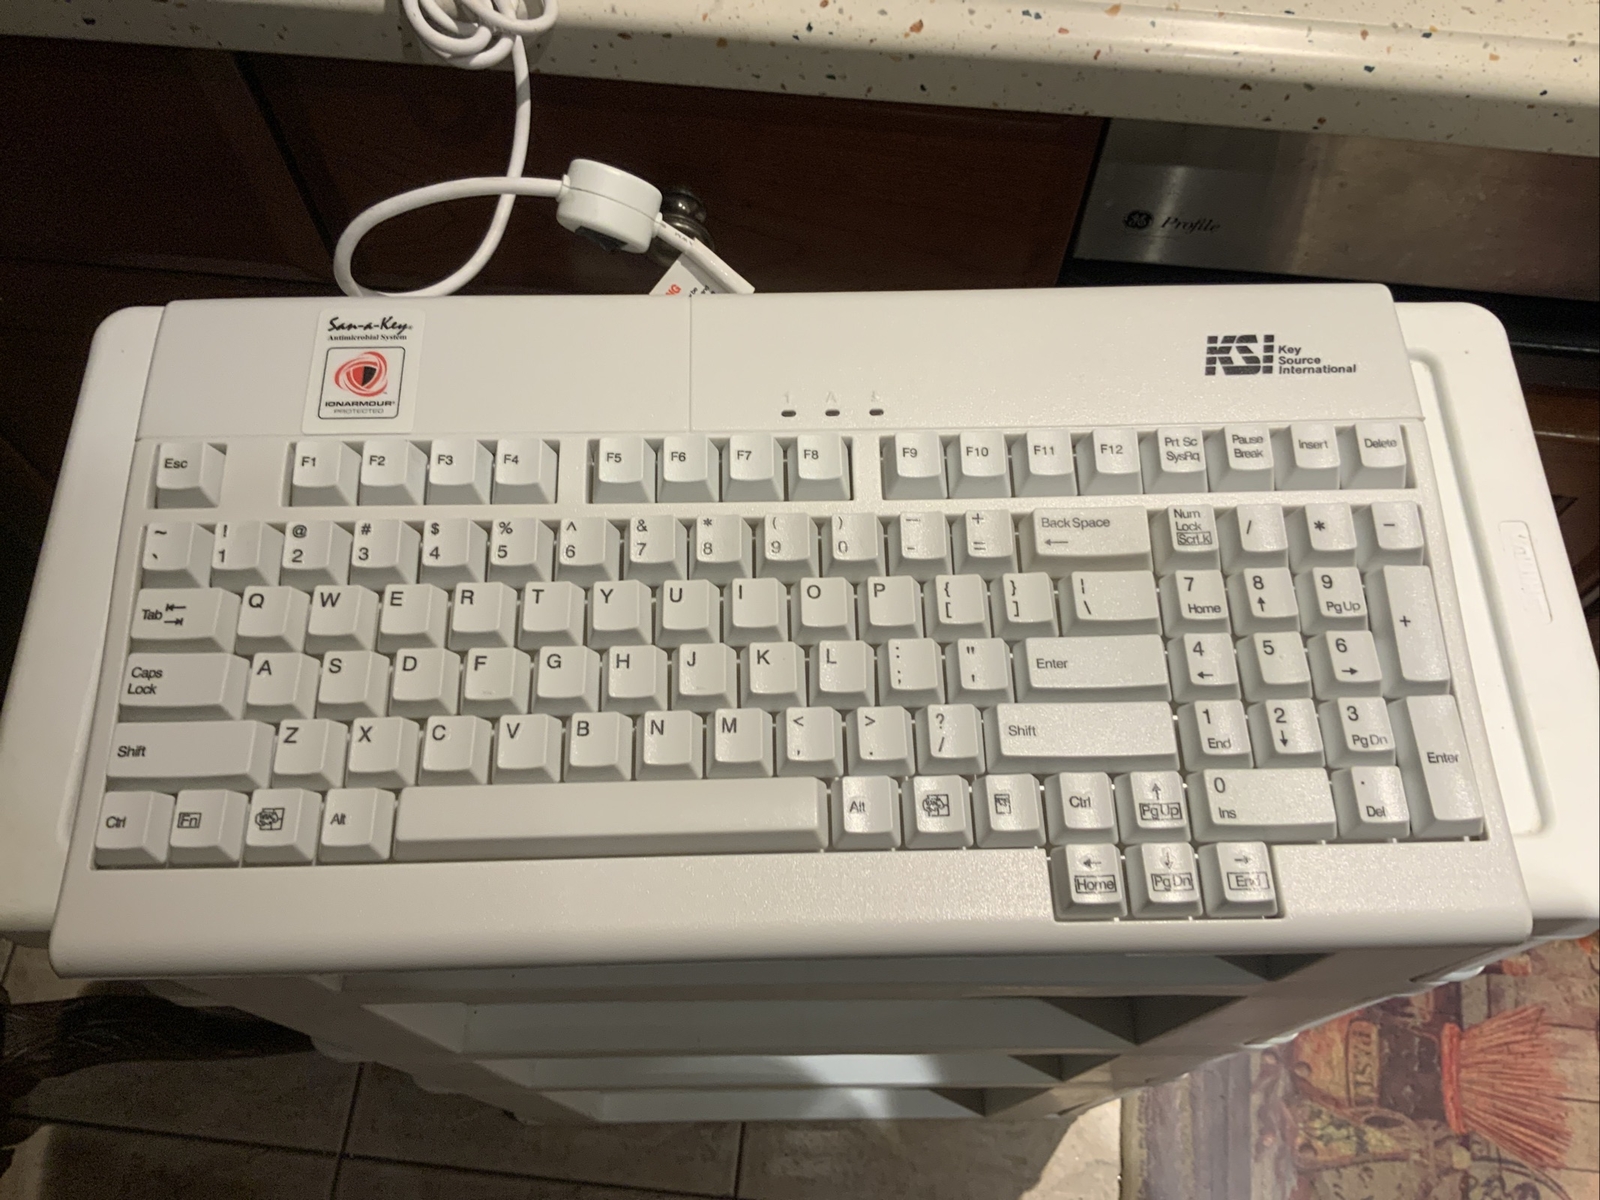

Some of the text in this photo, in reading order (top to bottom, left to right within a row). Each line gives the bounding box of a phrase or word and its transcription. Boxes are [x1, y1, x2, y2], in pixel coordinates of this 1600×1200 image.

[1161, 216, 1221, 234] Profile
[1205, 335, 1274, 375] KSI
[1278, 345, 1302, 356] Key
[1278, 355, 1321, 365] Source
[1278, 364, 1357, 375] International
[1164, 437, 1198, 447] Prt Sc
[1232, 434, 1264, 444] Pause
[1298, 440, 1328, 449] Insert
[1364, 438, 1397, 448] Delete
[737, 450, 752, 460] F7
[804, 449, 819, 460] F8
[902, 447, 918, 458] F9
[966, 446, 989, 457] F10
[1033, 445, 1054, 455] F11
[1100, 444, 1123, 454] F12
[1234, 448, 1263, 458] Break
[301, 456, 316, 467] F1
[369, 455, 385, 466] F2
[438, 454, 453, 465] F3
[504, 454, 519, 464] F4
[606, 452, 622, 463] F5
[671, 451, 686, 462] F6
[164, 458, 187, 469] Esc
[972, 513, 984, 524] +
[1173, 509, 1200, 519] Num
[361, 523, 371, 535] #
[431, 522, 439, 535] $
[499, 522, 513, 534] %
[636, 519, 647, 532] &
[1041, 517, 1110, 530] Back Space
[1175, 521, 1202, 535] Lock
[292, 525, 307, 538] @
[429, 546, 440, 559] 4
[498, 545, 507, 558] 5
[565, 545, 575, 558] 6
[637, 542, 647, 556] 7
[703, 542, 713, 555] 8
[771, 540, 781, 553] 9
[838, 540, 848, 554] 0
[219, 549, 225, 563] 1
[291, 549, 303, 563] 2
[358, 547, 369, 561] 3
[1010, 580, 1016, 596] }
[1184, 577, 1194, 591] 7
[1253, 575, 1264, 590] 8
[1321, 575, 1333, 589] 9
[600, 589, 613, 603] Y
[670, 588, 682, 603] U
[739, 585, 742, 599] I
[807, 585, 821, 599] O
[874, 583, 885, 597] P
[944, 582, 950, 597] {
[248, 593, 264, 608] Q
[320, 592, 341, 607] W
[390, 591, 403, 606] E
[461, 590, 474, 605] R
[532, 589, 544, 604] T
[945, 602, 952, 618] [
[1013, 601, 1019, 617] ]
[1188, 604, 1221, 614] Home
[1326, 601, 1361, 614] Pg Up
[142, 609, 163, 620] Tab
[1400, 616, 1411, 627] +
[1193, 641, 1204, 656] 4
[1263, 640, 1275, 655] 5
[1335, 638, 1347, 653] 6
[547, 654, 561, 669] G
[616, 654, 630, 669] H
[687, 652, 696, 667] J
[757, 650, 770, 665] K
[826, 648, 837, 664] L
[257, 660, 272, 675] A
[329, 658, 342, 674] S
[402, 656, 417, 671] D
[474, 656, 487, 671] F
[1036, 658, 1068, 669] Enter
[131, 667, 163, 680] Caps
[127, 683, 156, 695] Lock
[1203, 709, 1211, 724] 1
[1274, 707, 1287, 723] 2
[1347, 706, 1359, 721] 3
[651, 720, 664, 735] N
[722, 717, 737, 733] M
[793, 716, 804, 727] <
[865, 716, 875, 726] >
[936, 713, 945, 729] ?
[358, 726, 372, 742] X
[432, 725, 446, 741] C
[507, 723, 520, 739] V
[577, 721, 589, 736] B
[1008, 725, 1036, 736] Shift
[283, 727, 299, 744] Z
[1352, 734, 1388, 748] Pg Dn
[1207, 738, 1231, 749] End
[117, 746, 146, 758] Shift
[1427, 752, 1458, 764] Enter
[1214, 777, 1226, 793] 0
[849, 801, 865, 813] Alt
[1069, 796, 1091, 808] Ctrl
[1143, 804, 1158, 820] Pg
[1218, 807, 1237, 819] Ins
[1366, 806, 1386, 817] Del
[106, 816, 126, 828] Ctrl
[330, 813, 346, 825] Alt
[1077, 879, 1114, 890] Home
[1155, 875, 1171, 891] Pg
